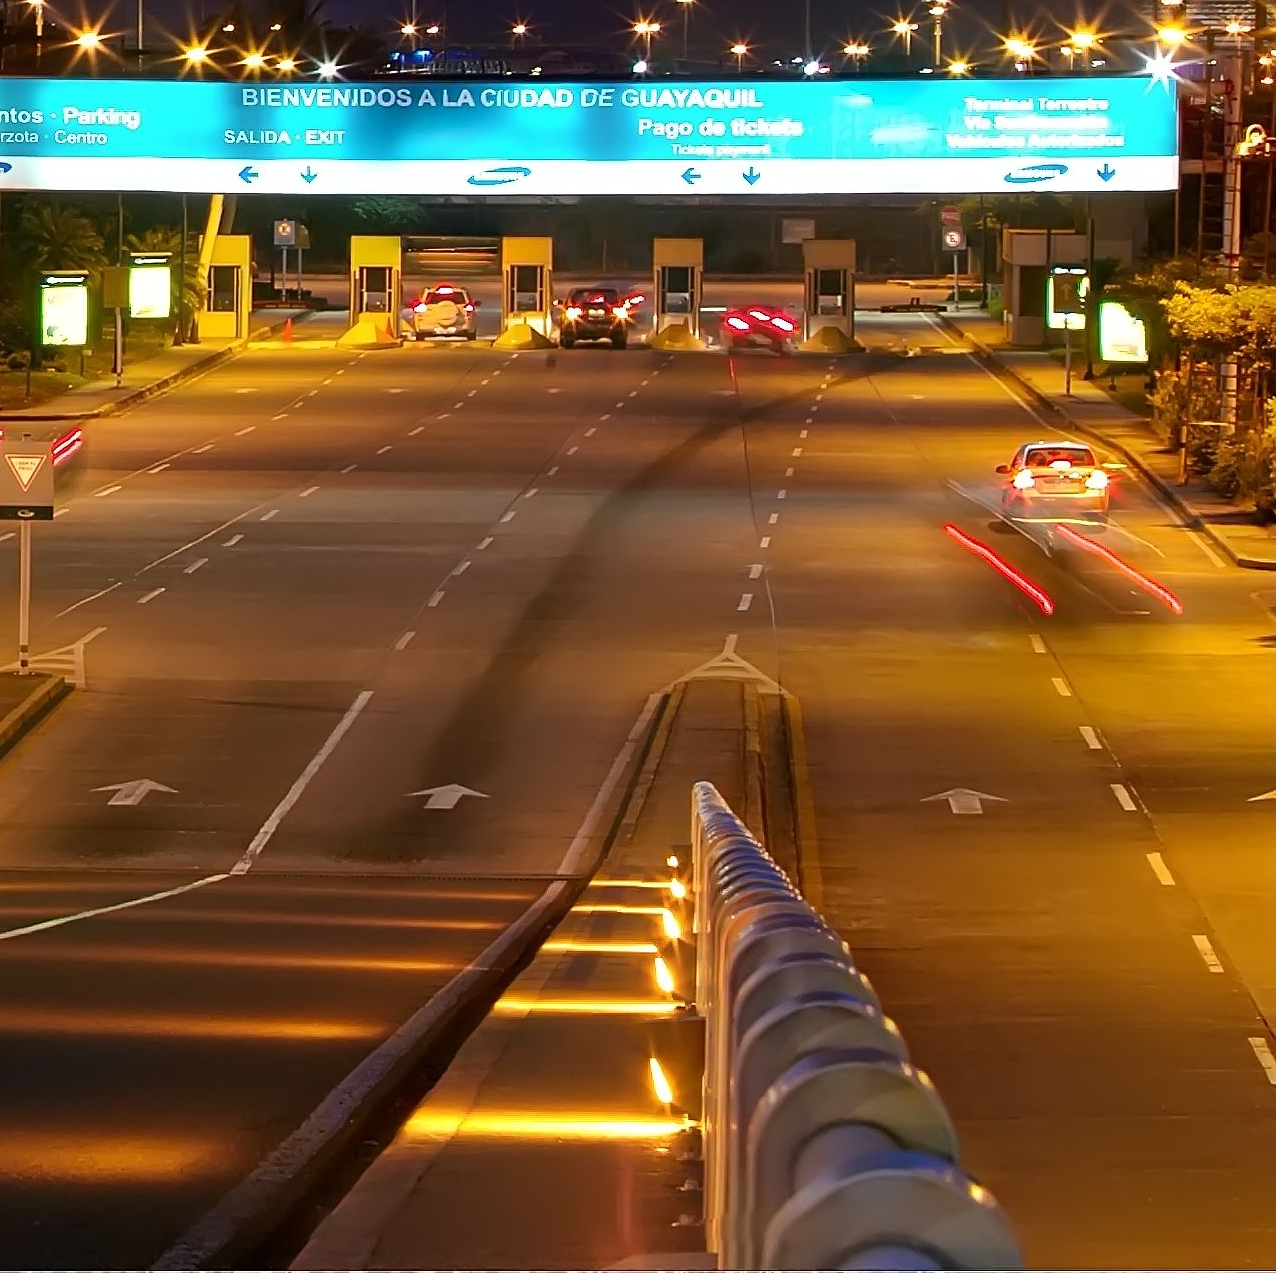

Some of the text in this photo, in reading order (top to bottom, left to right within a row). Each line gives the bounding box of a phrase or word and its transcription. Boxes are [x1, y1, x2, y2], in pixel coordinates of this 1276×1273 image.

[241, 88, 764, 108] BIENVENIDOS A LA CIUDAD DE GUAYAQUIL
[62, 106, 141, 130] Parking
[54, 129, 108, 145] Centro
[224, 129, 345, 144] SALIDA EXIT
[638, 118, 694, 140] Pago
[699, 117, 727, 137] de
